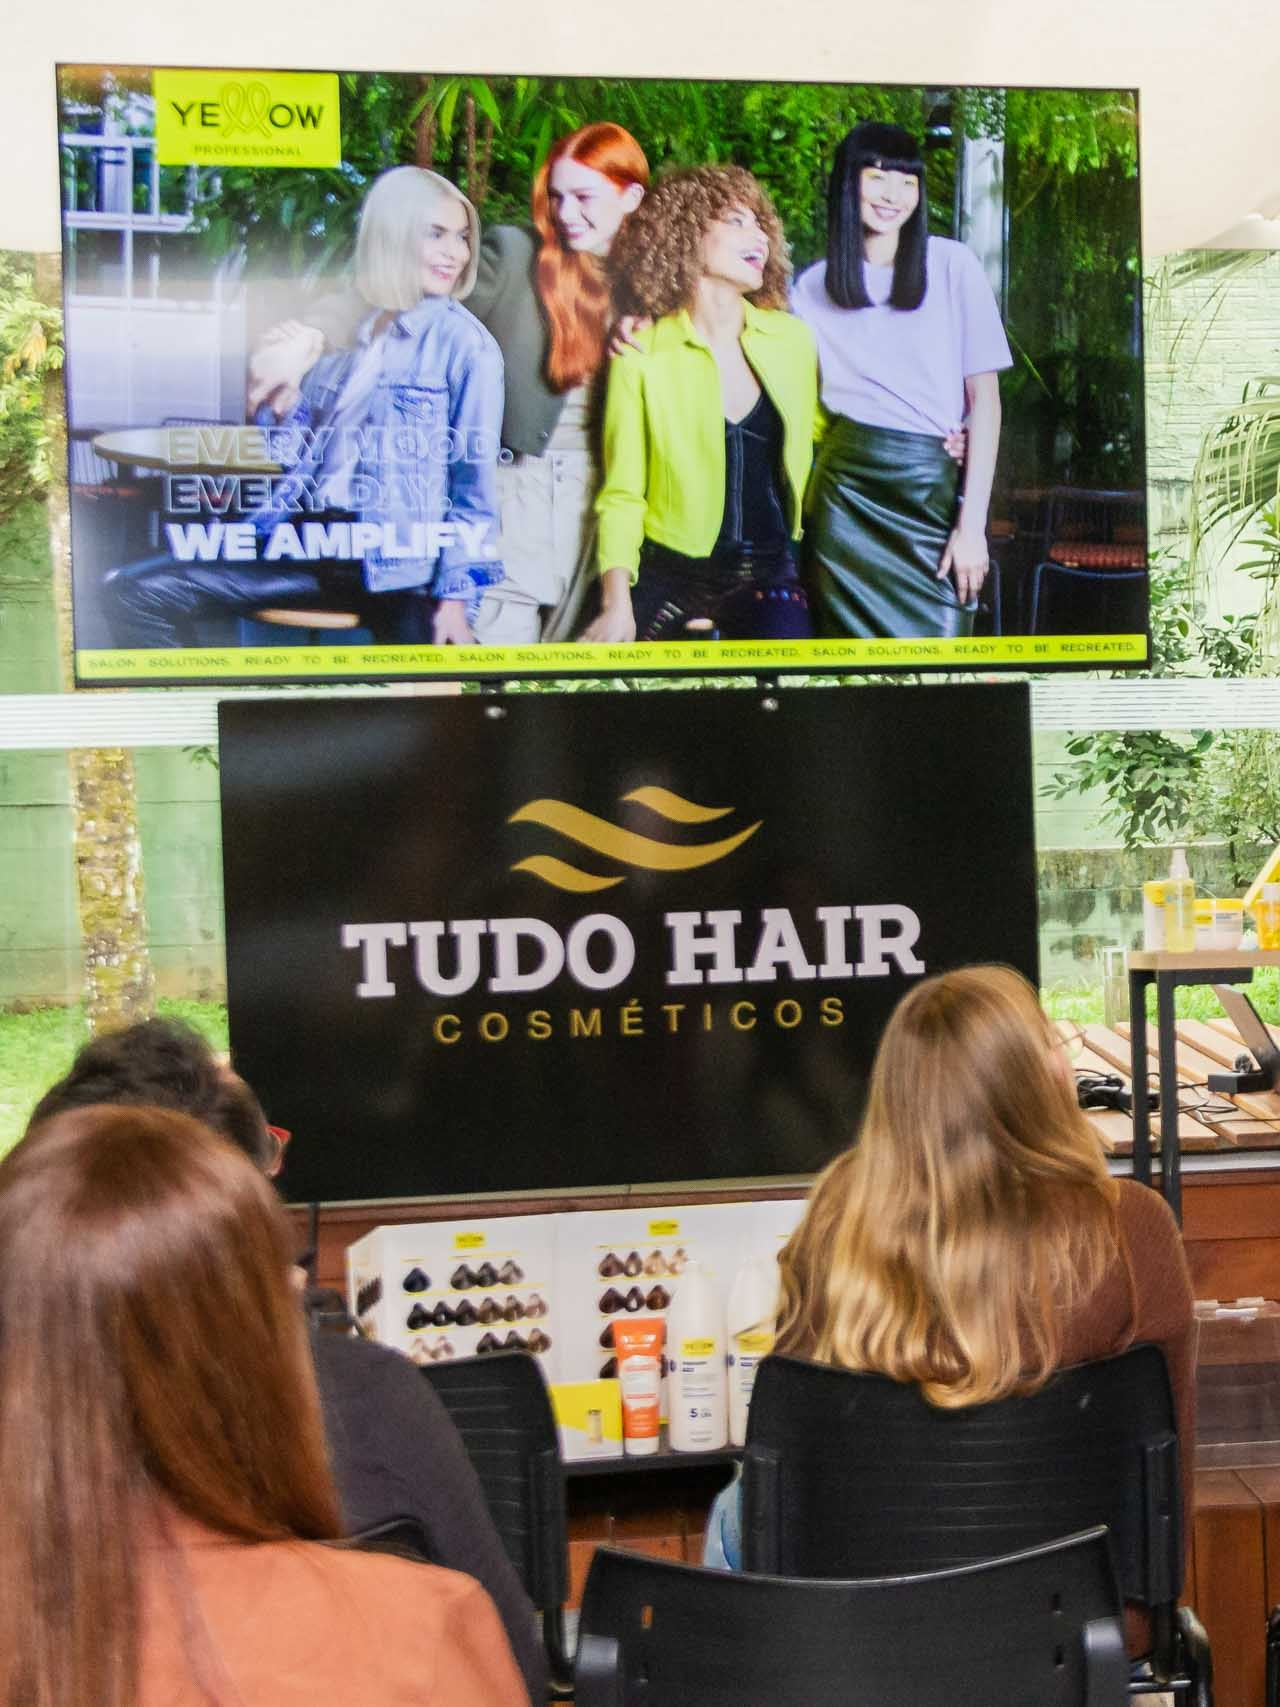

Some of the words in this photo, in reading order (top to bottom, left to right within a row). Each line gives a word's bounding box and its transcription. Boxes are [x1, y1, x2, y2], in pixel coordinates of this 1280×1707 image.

[194, 144, 302, 156] PROFESSIONAL
[167, 426, 334, 465] EVERY
[168, 474, 333, 512] EVERY
[165, 522, 257, 561] WE
[263, 521, 499, 560] AMPLIFY.
[245, 655, 290, 665] READY
[303, 655, 321, 665] TO
[459, 652, 505, 662] SALON
[608, 650, 653, 660] READY
[664, 649, 681, 659] TO
[812, 646, 856, 656] SALON
[954, 644, 995, 654] READY
[1006, 643, 1024, 653] TO
[341, 913, 636, 998] TUDO
[664, 903, 926, 986] HAIR
[433, 997, 845, 1044] COSMÉTICOS
